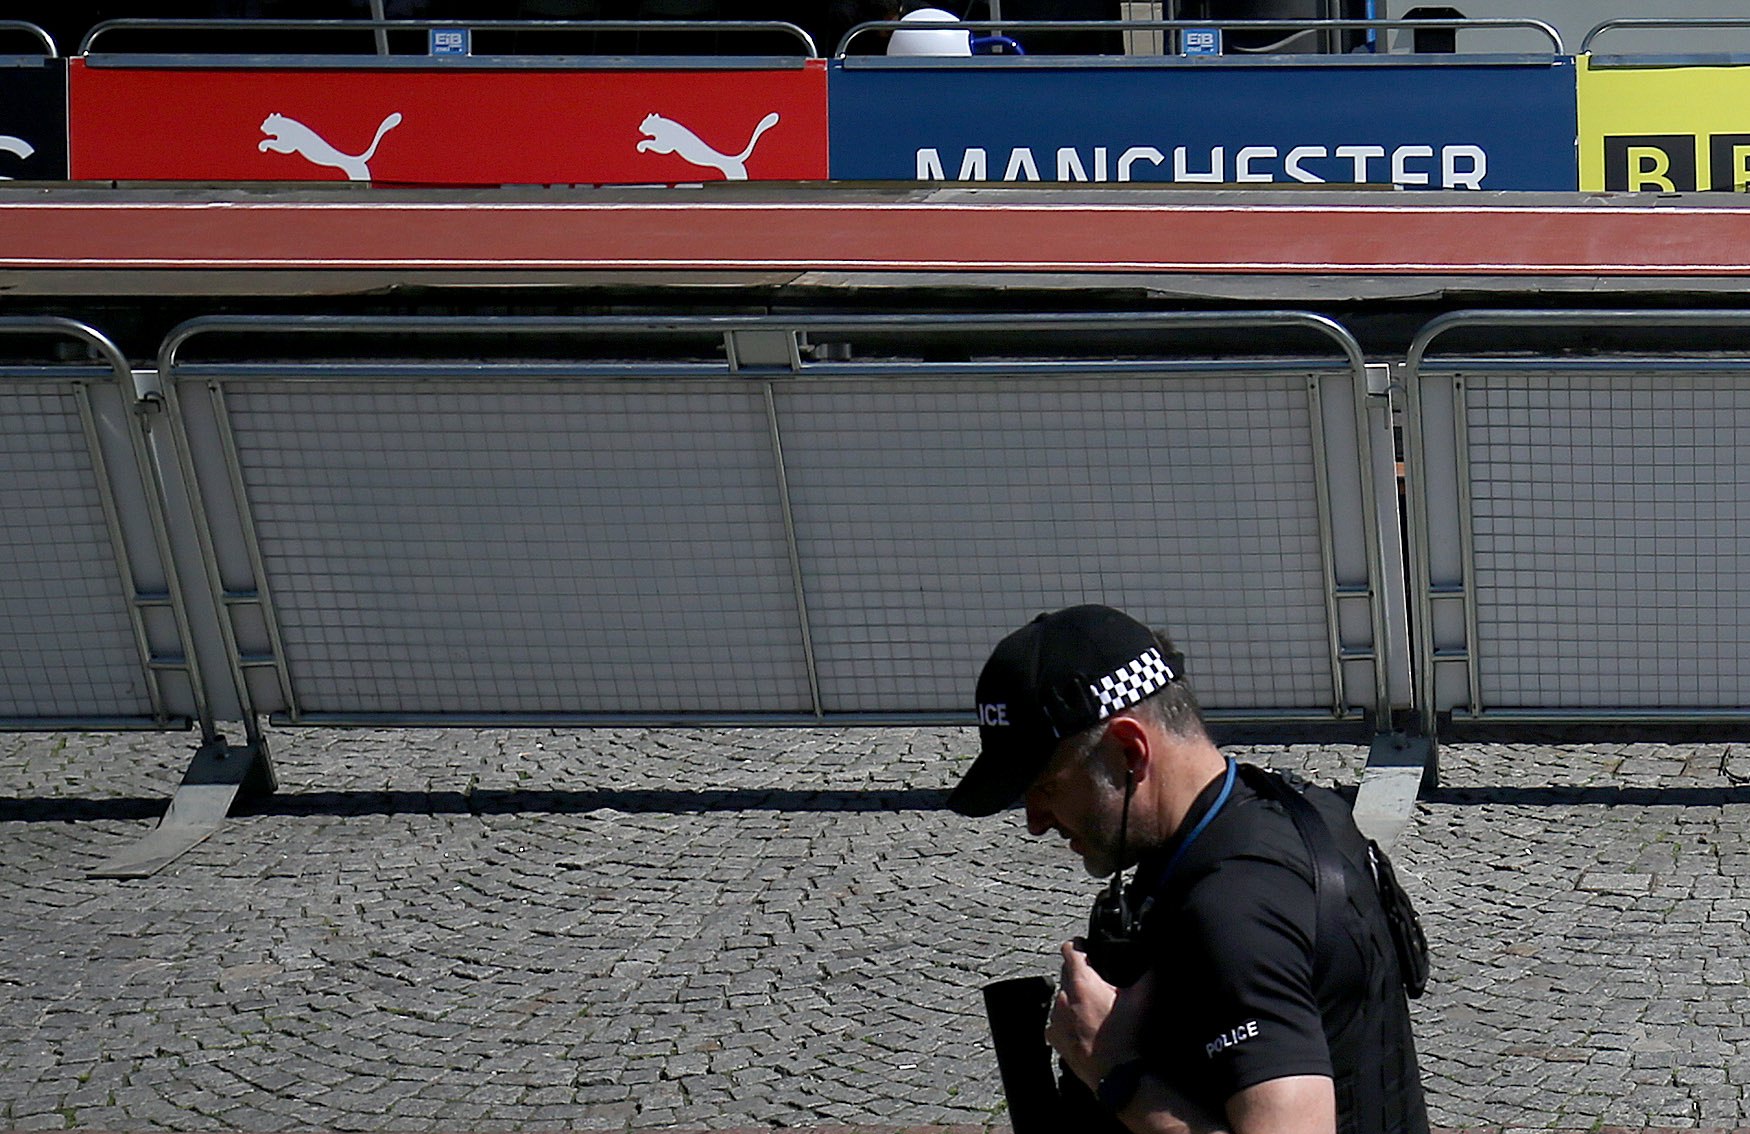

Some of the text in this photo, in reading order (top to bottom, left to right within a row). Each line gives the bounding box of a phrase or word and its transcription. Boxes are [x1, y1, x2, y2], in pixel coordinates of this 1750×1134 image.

[917, 146, 1487, 189] MANCHESTER
[979, 703, 1010, 726] ICE
[1206, 1021, 1259, 1058] POLICE
